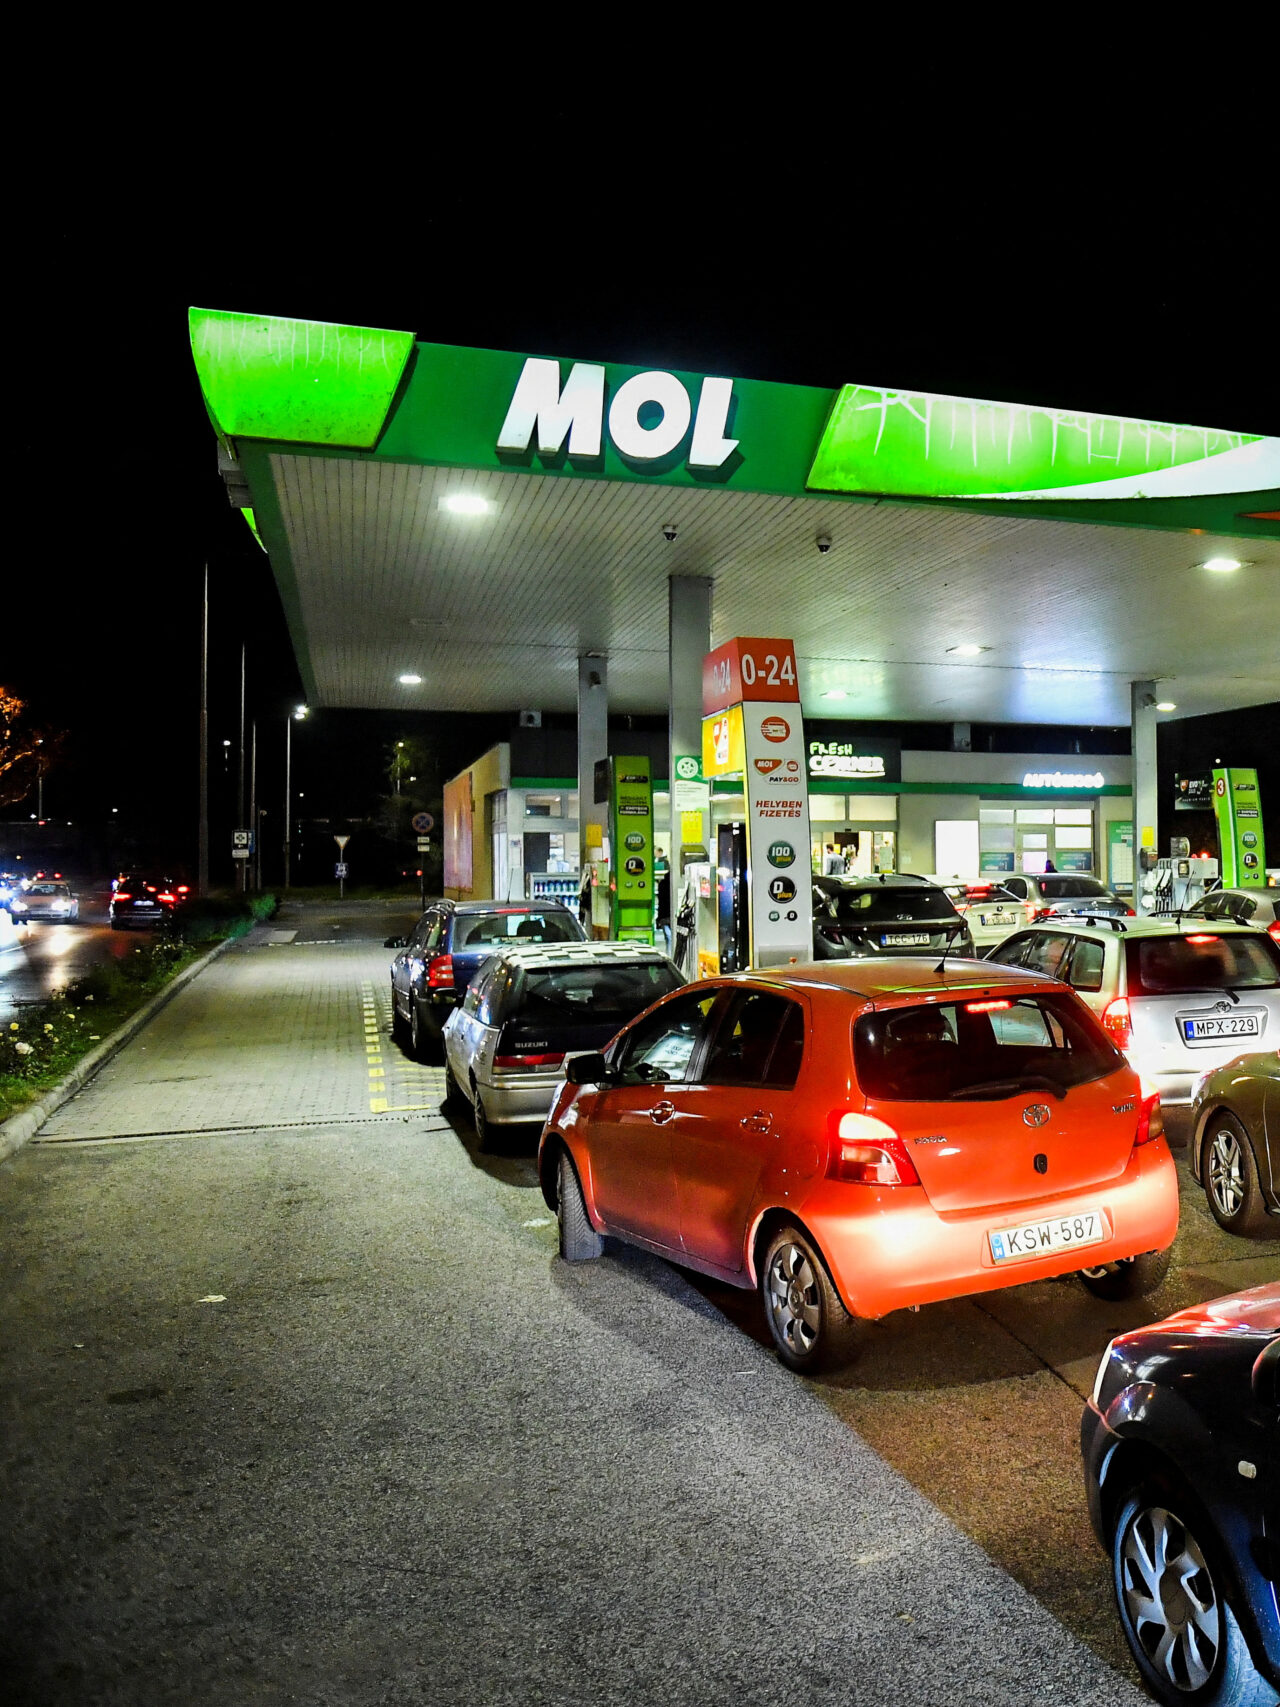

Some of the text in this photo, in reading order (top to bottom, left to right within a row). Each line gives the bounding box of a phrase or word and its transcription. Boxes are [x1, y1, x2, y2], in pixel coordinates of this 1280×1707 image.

[496, 357, 739, 467] MOL
[742, 654, 795, 685] 0-24
[809, 742, 853, 755] FRESH
[1217, 780, 1224, 796] 3
[755, 800, 803, 808] HELYBEN
[759, 808, 801, 818] FIZETÉS
[772, 846, 790, 856] 100
[628, 860, 636, 868] D
[1245, 855, 1252, 863] D
[773, 881, 784, 894] D
[1196, 1018, 1254, 1035] MPX-229
[1007, 1216, 1094, 1254] KSW-587
